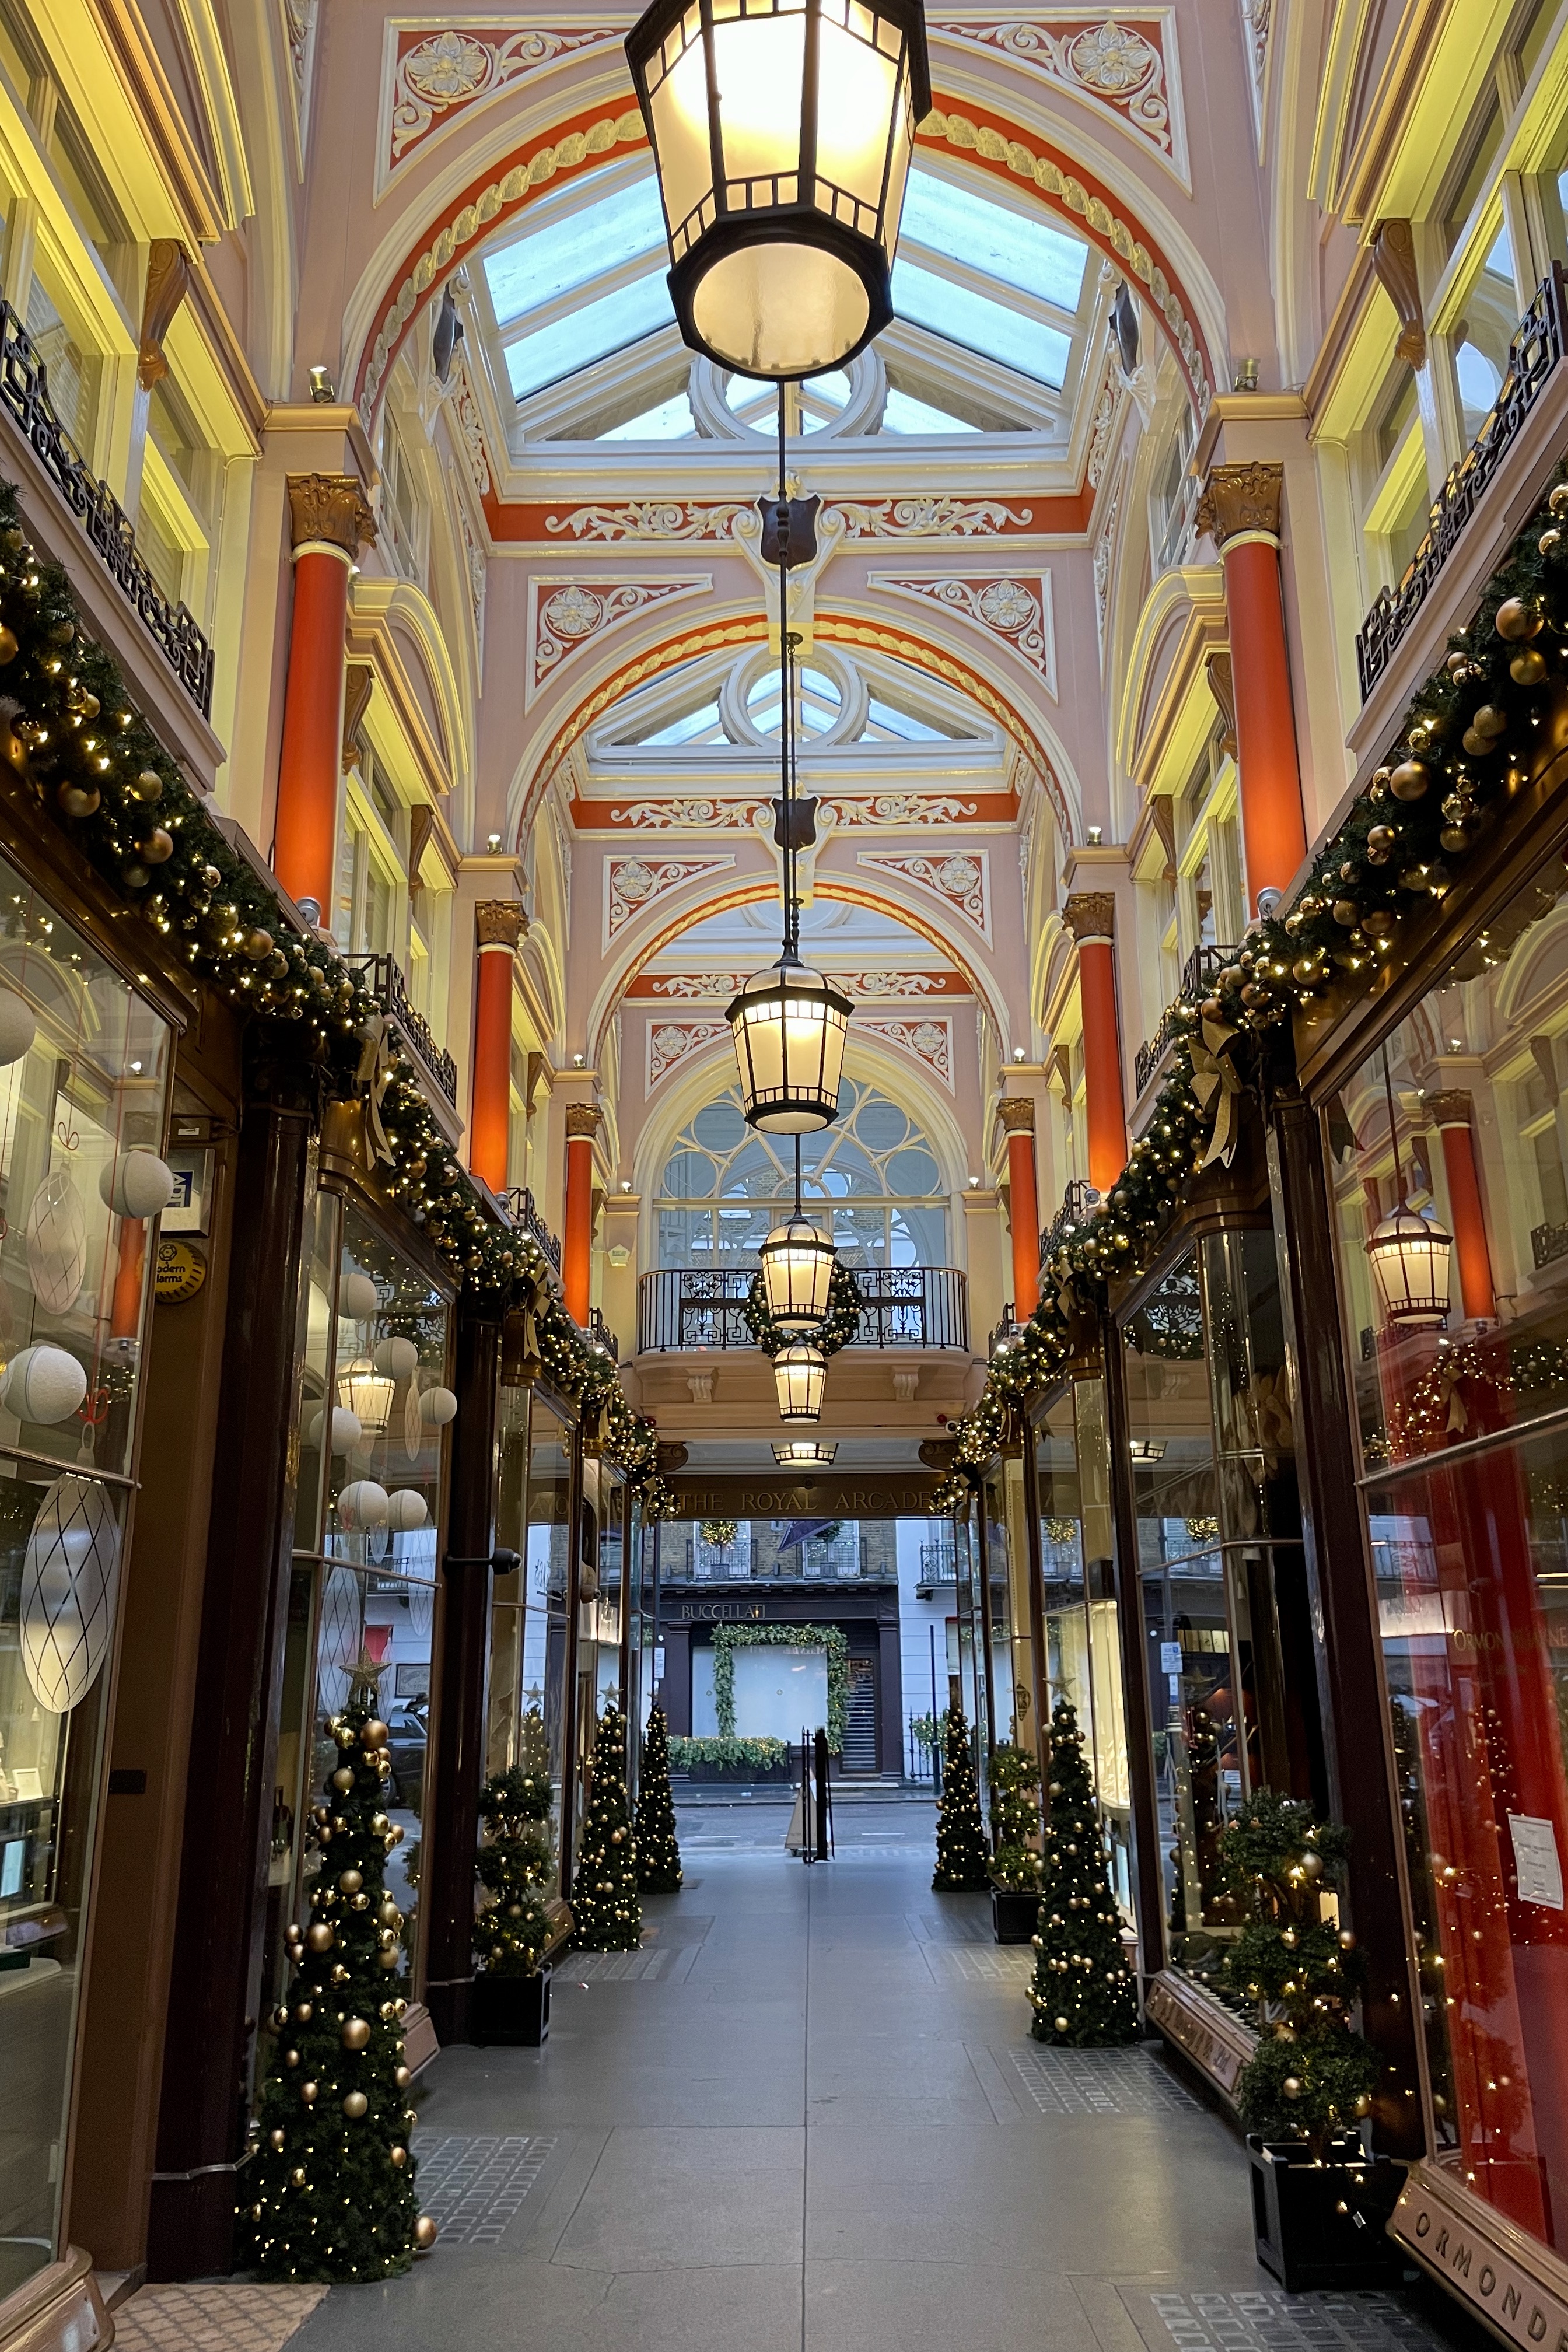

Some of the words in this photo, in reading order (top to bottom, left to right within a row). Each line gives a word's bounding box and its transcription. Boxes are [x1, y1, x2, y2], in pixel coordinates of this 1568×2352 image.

[157, 1264, 186, 1273] odern
[156, 1274, 183, 1283] larms
[680, 1493, 724, 1511] THE
[741, 1492, 818, 1511] ROYAL
[835, 1491, 932, 1511] ARCADE
[682, 1604, 766, 1619] BUCCELLATI
